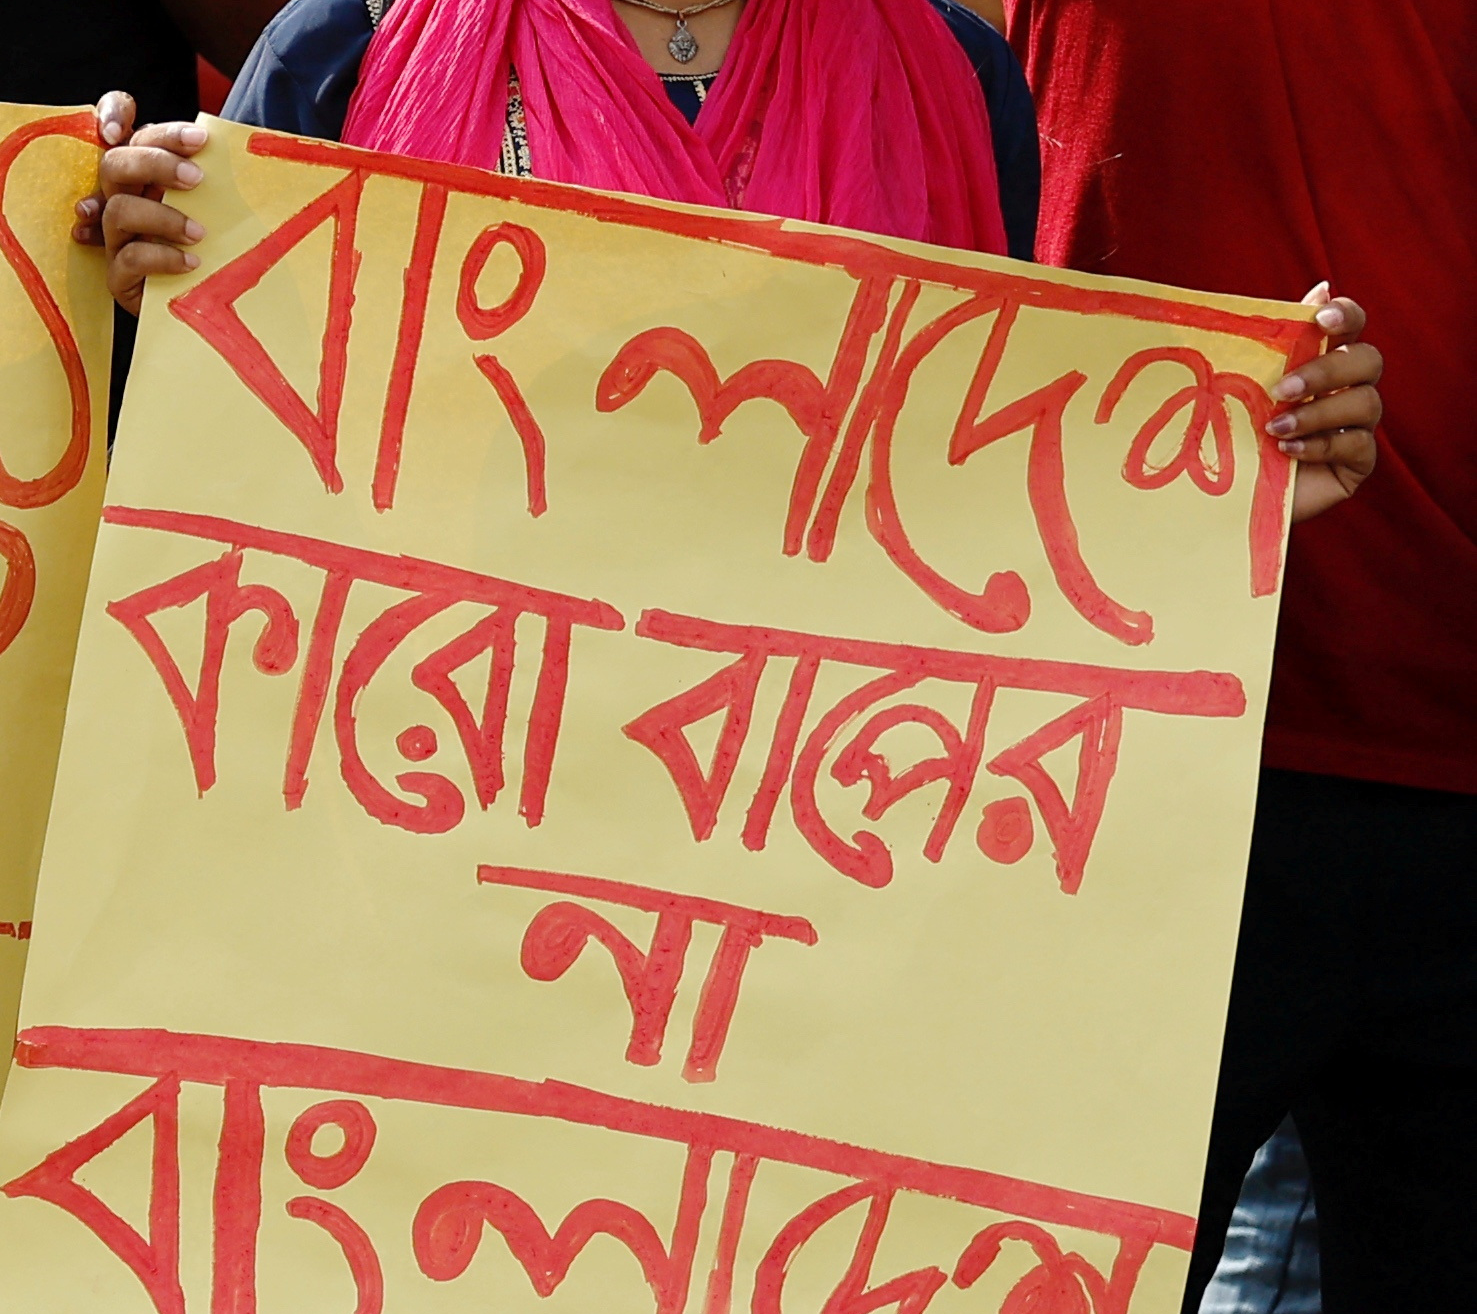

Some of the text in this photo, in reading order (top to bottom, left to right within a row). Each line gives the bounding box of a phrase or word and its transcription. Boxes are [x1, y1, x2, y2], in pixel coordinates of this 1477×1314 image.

[105, 505, 1247, 895] কারো বাপের
[476, 863, 818, 1083] না
